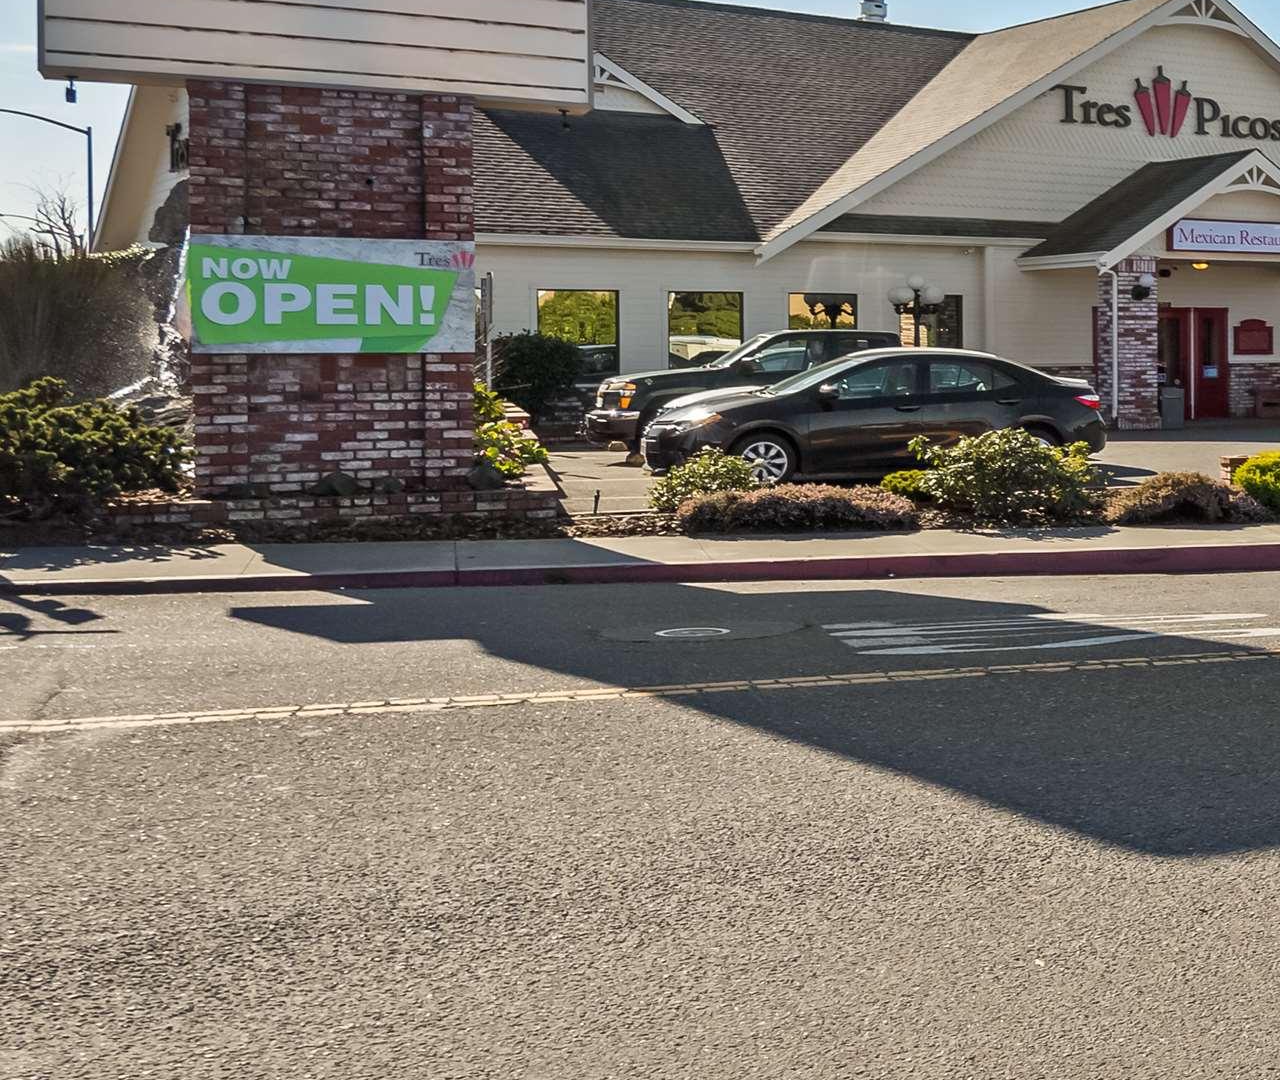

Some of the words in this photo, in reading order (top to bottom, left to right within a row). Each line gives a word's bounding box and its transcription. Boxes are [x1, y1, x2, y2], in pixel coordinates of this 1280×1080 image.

[1050, 84, 1131, 127] Tres
[1178, 227, 1236, 245] Mexican
[202, 257, 292, 280] NOW
[414, 251, 450, 268] Tres
[200, 283, 436, 326] OPEN!
